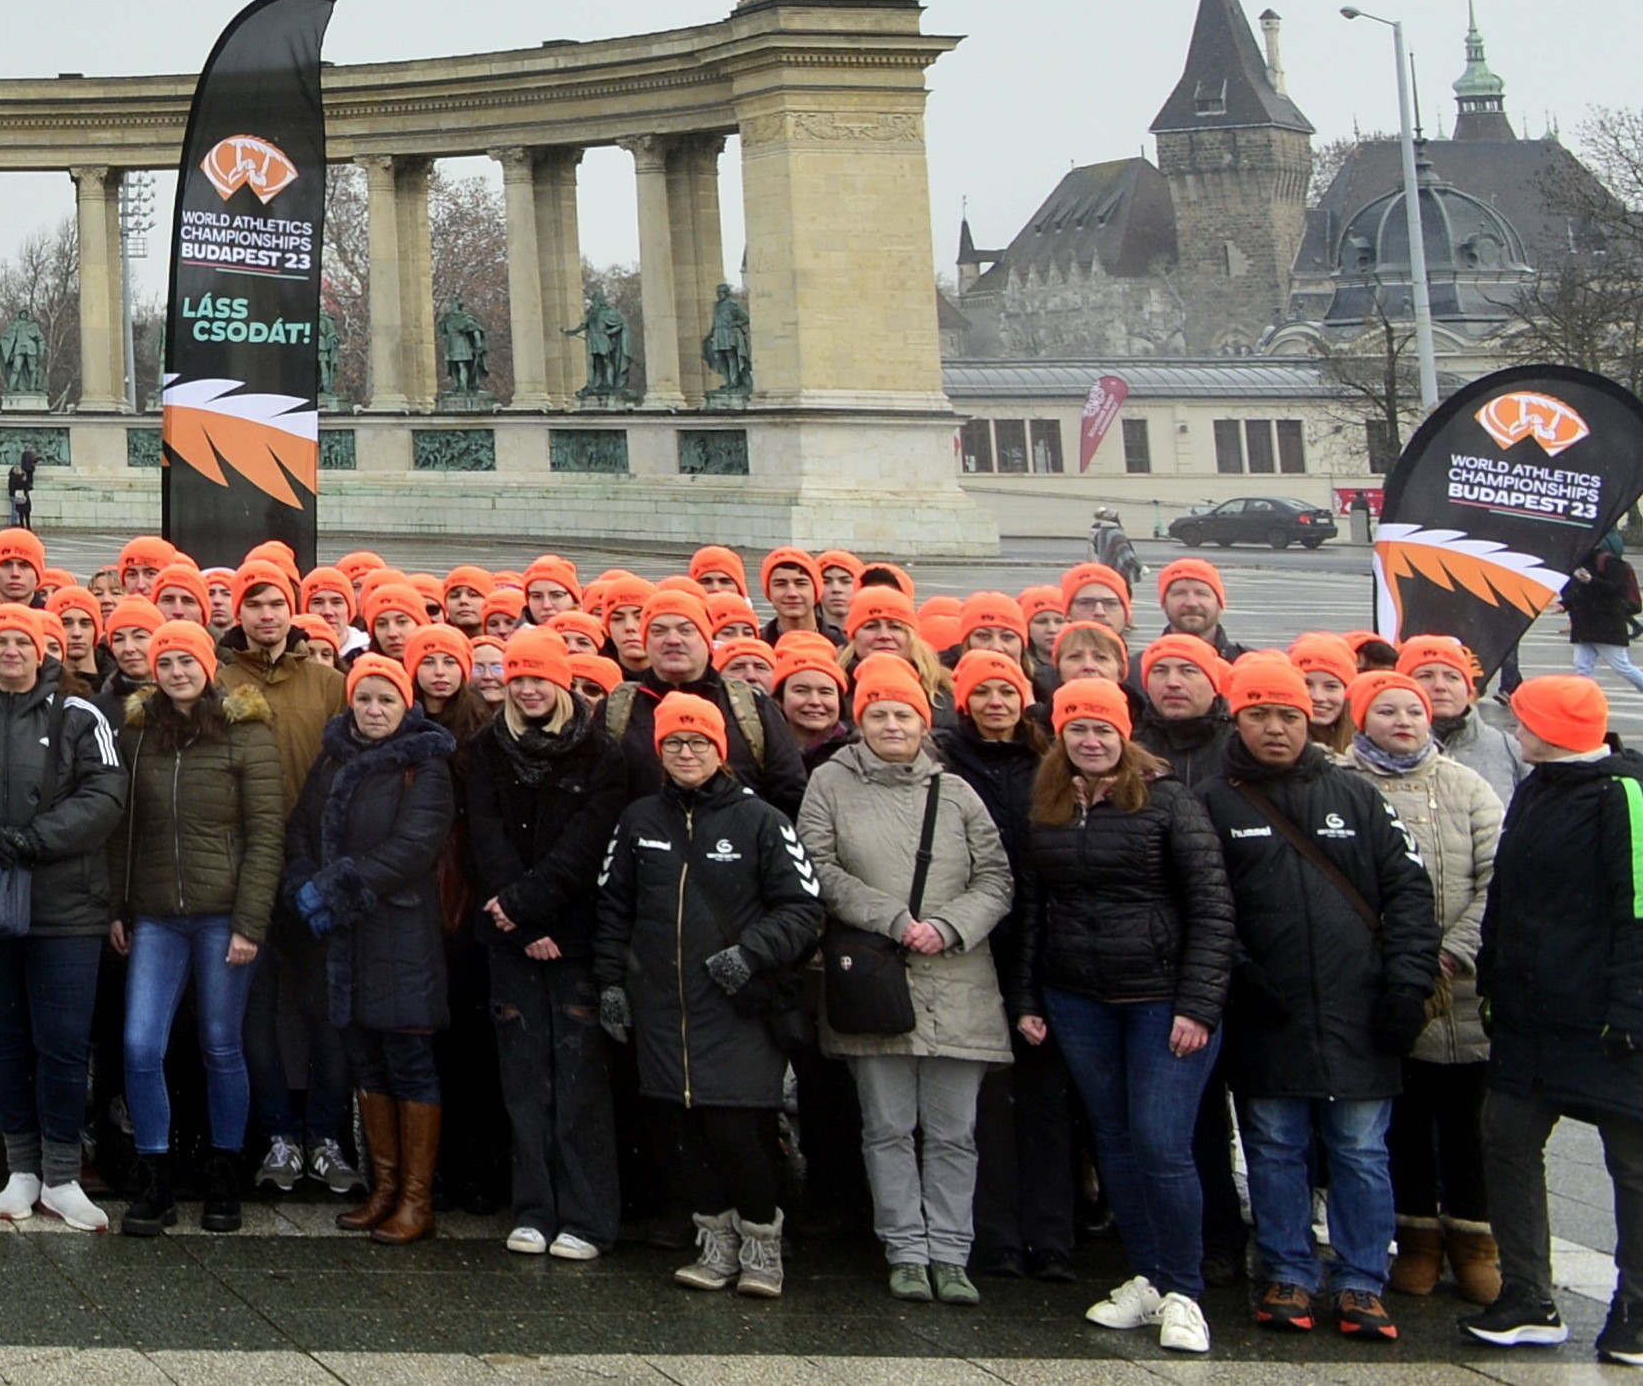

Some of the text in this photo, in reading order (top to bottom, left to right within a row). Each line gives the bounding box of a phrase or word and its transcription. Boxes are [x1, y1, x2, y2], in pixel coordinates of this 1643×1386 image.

[181, 210, 313, 235] WORLD ATHLETICS
[180, 225, 312, 252] CHAMPIONSHIPS
[181, 242, 312, 270] BUDAPEST 23
[182, 292, 249, 319] LÁSS
[193, 317, 312, 344] CSODÁT!
[1451, 454, 1602, 488] WORLD ATHLETICS
[1448, 468, 1600, 503] CHAMPIONSHIPS
[1448, 482, 1598, 519] BUDAPEST 23
